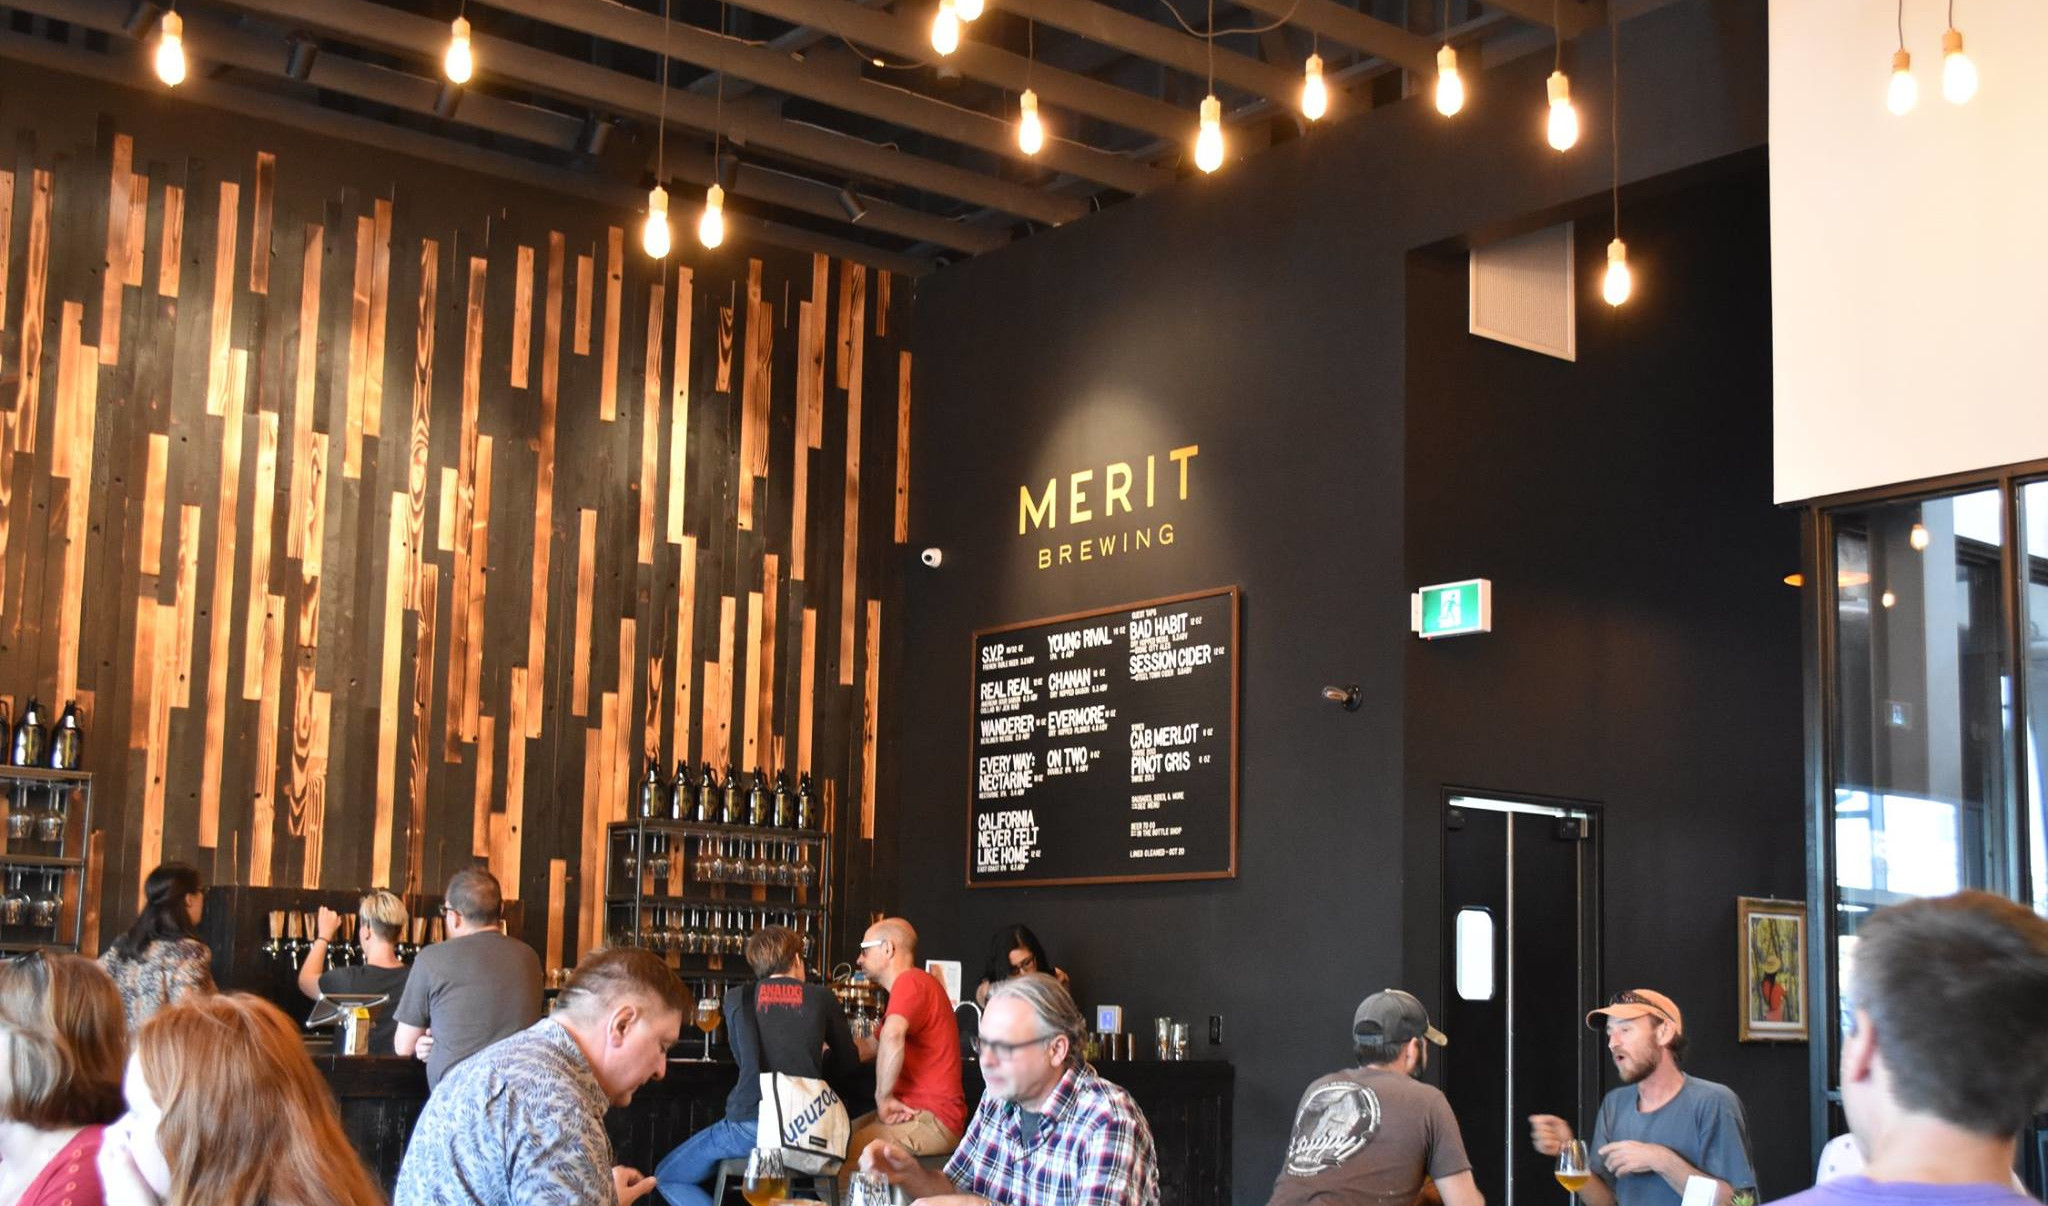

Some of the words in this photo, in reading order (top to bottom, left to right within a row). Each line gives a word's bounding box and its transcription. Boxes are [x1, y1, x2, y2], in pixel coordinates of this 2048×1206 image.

[1018, 444, 1199, 535] MERIT
[1038, 523, 1174, 569] BREWING
[1129, 619, 1152, 640] BAD
[1154, 612, 1188, 636] HABIT
[1047, 630, 1081, 653] YOUNG
[1083, 625, 1112, 648] RIVAL
[1129, 648, 1176, 675] SESSION
[1177, 643, 1211, 667] CIDER
[981, 680, 1006, 700] REAL
[1007, 676, 1033, 697] REAL
[1048, 667, 1091, 692] CHANAN
[980, 714, 1034, 737] WANDERER
[1048, 704, 1105, 730] EVERMORE
[1130, 729, 1153, 750] CAB
[1154, 723, 1199, 748] MERLOT
[980, 754, 1011, 775] EVERY
[1012, 751, 1035, 772] WAY:
[1046, 749, 1062, 768] ON
[1063, 746, 1087, 766] TWO
[1131, 753, 1163, 776] PINOT
[1164, 751, 1191, 773] GRIS
[979, 769, 1033, 791] NECTARINE
[978, 809, 1034, 831] CALIFORNIA
[977, 828, 1011, 848] NEVER
[1013, 826, 1039, 846] FELT
[977, 847, 999, 866] LIKE
[1000, 845, 1029, 865] HOME
